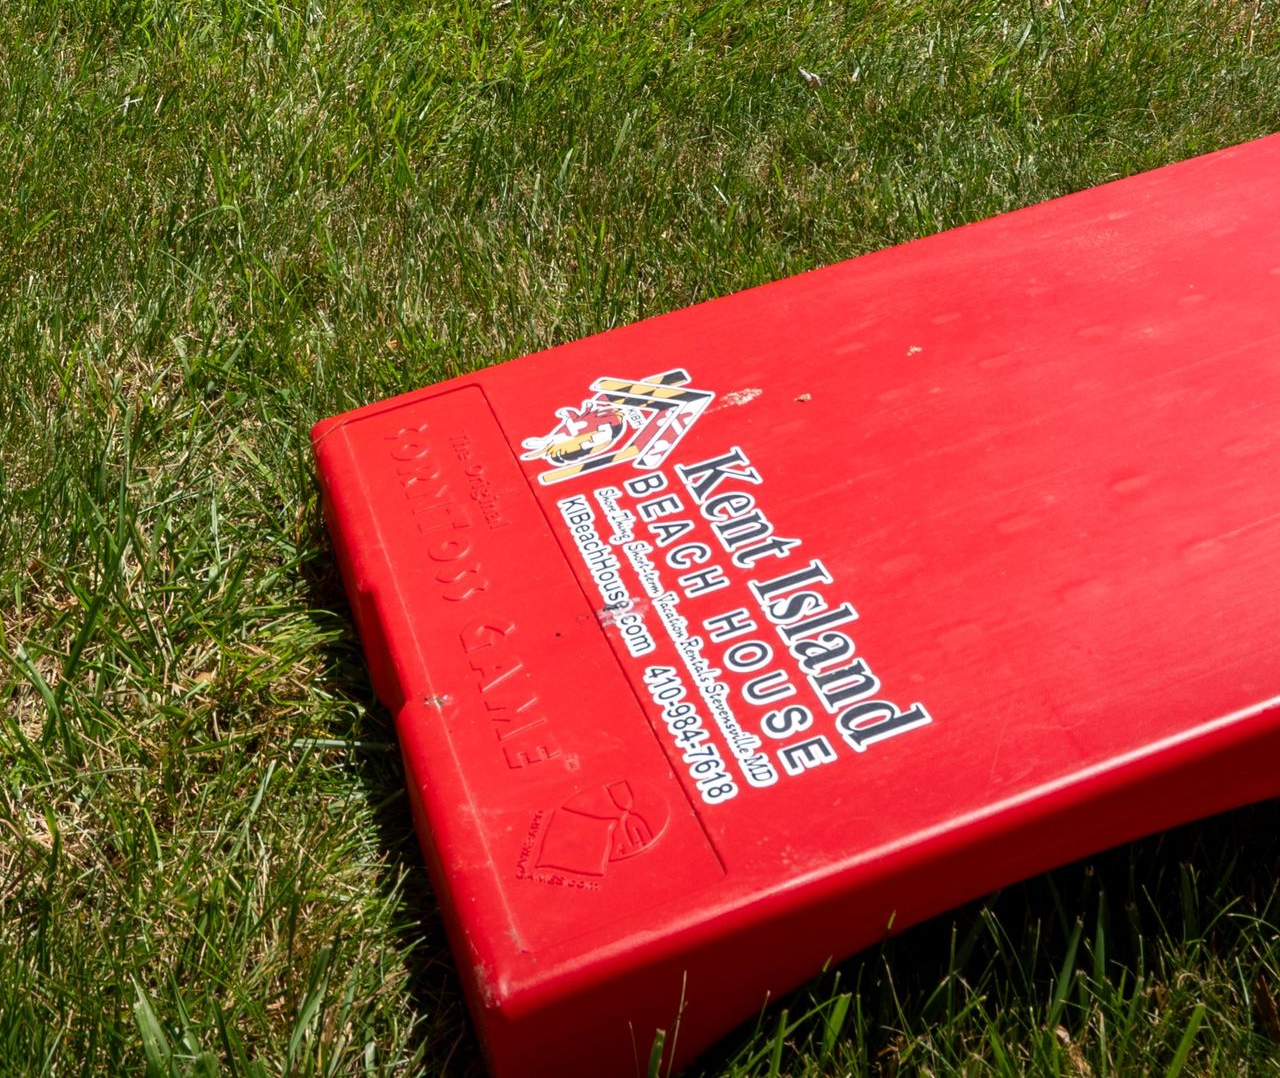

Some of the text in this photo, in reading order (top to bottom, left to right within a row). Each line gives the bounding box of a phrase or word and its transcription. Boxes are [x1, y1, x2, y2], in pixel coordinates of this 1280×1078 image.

[465, 465, 511, 530] Original
[598, 488, 774, 782] Shore Thing Short-term Vacation Rentals Stevensville MD
[628, 469, 831, 769] BEACH HOUSE
[679, 449, 925, 747] Kent Island
[562, 498, 733, 798] KIBeachHousecom 410-984-7618
